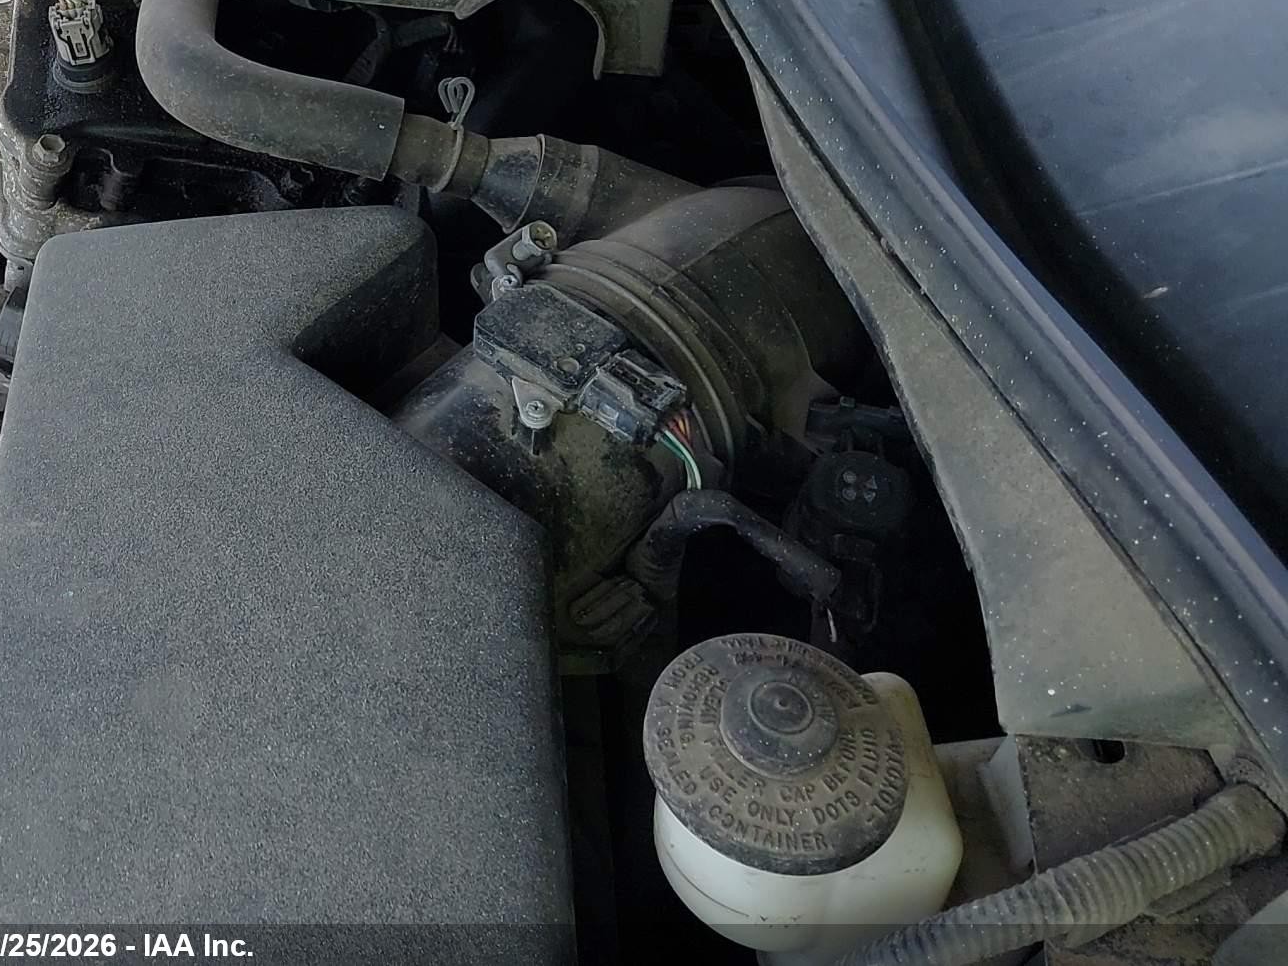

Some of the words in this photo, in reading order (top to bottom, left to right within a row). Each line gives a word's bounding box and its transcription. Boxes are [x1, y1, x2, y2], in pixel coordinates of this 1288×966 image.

[662, 652, 705, 690] FROM
[655, 725, 698, 798] SEALED
[699, 765, 739, 806] USE
[747, 800, 796, 827] ONLY
[857, 727, 881, 789] FLUID
[777, 784, 817, 804] CAP
